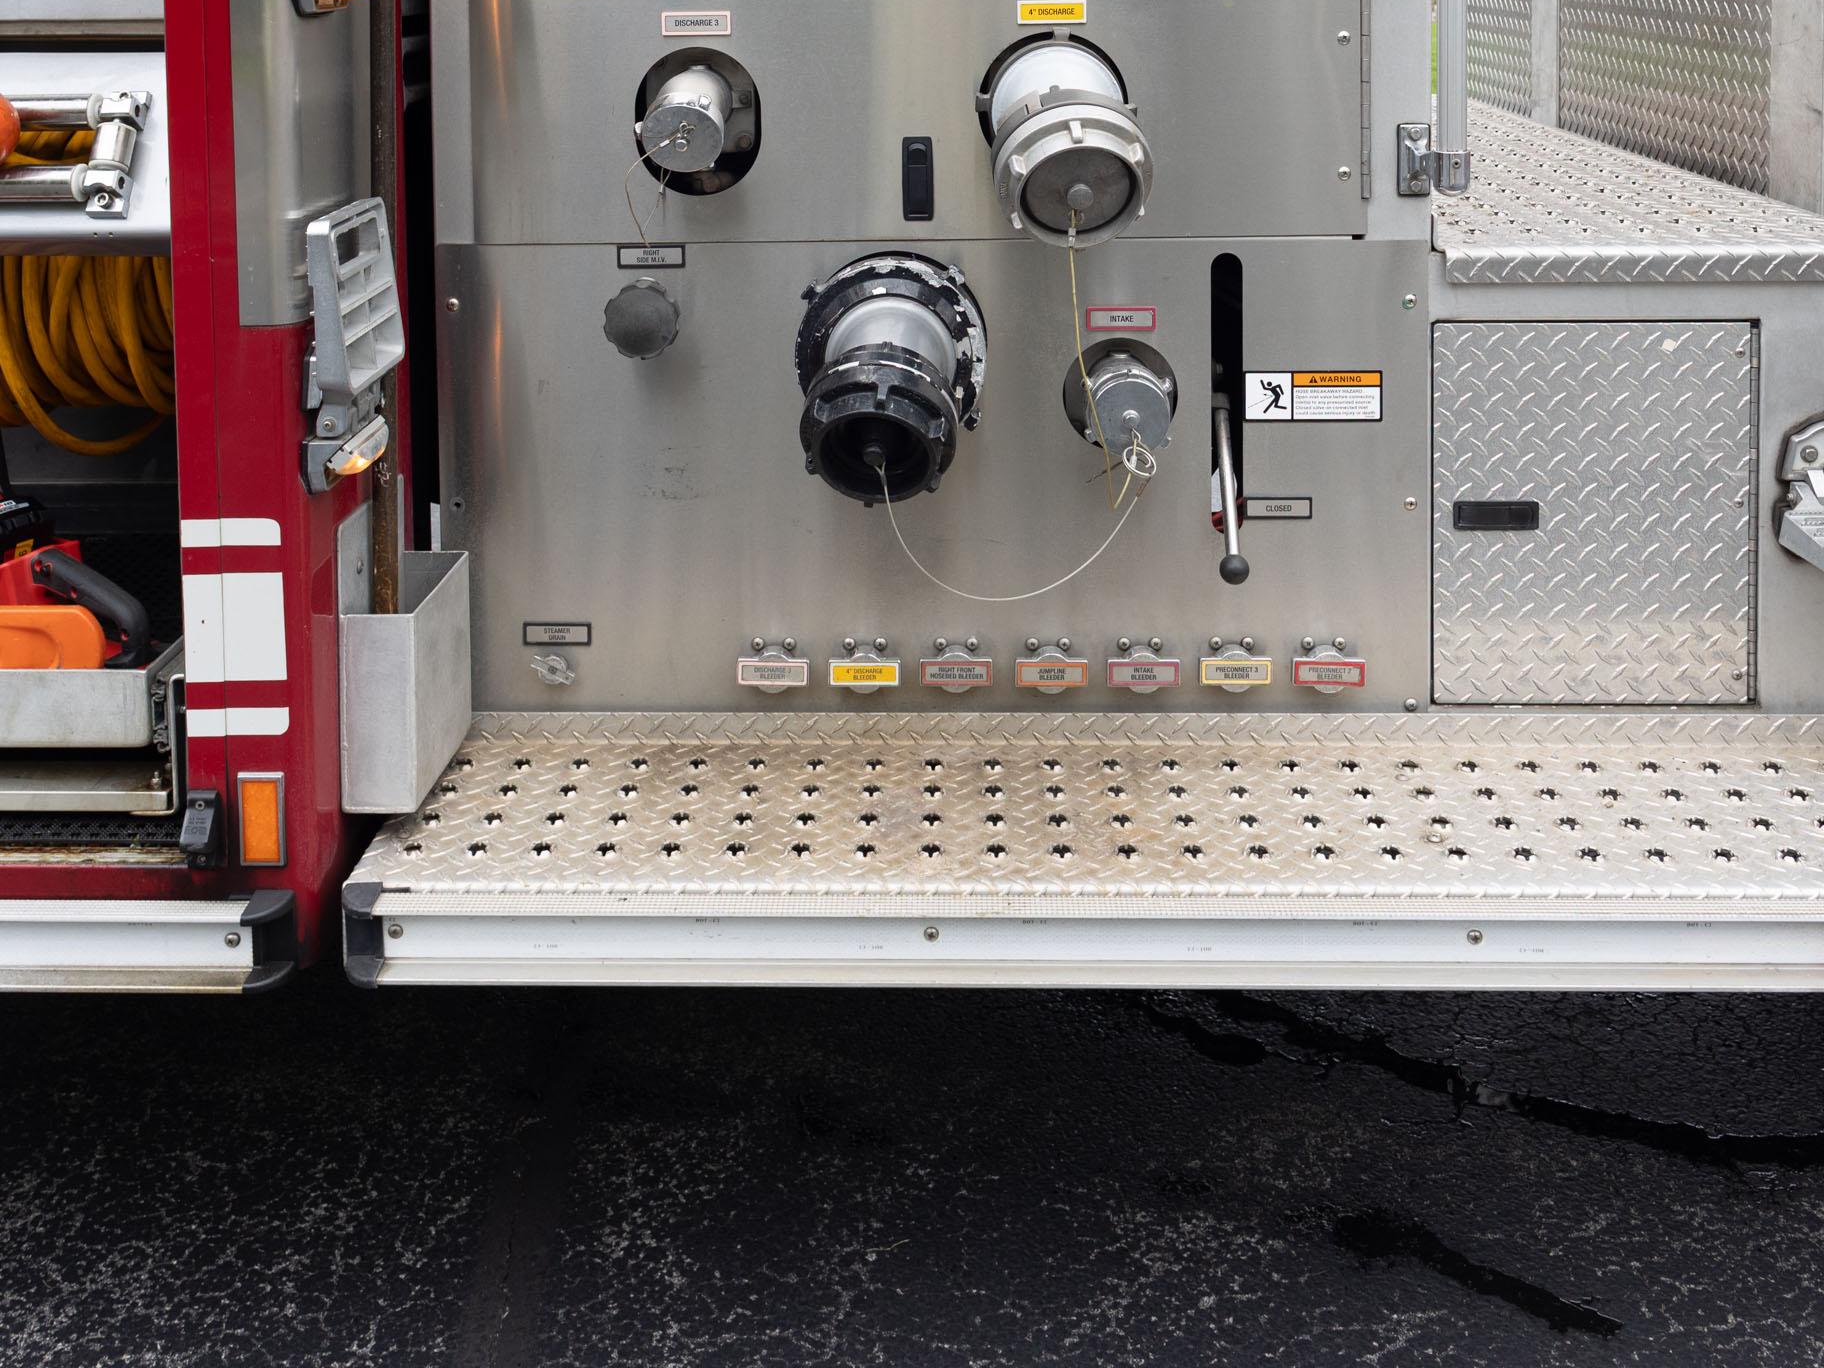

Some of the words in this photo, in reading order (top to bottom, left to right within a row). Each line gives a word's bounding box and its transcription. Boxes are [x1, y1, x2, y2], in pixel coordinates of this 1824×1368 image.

[1038, 7, 1075, 16] DISCHARGE
[674, 18, 713, 27] DISCHARGE
[714, 18, 719, 26] 3
[1320, 375, 1362, 383] WARNING
[1265, 504, 1292, 512] CLOSED
[1308, 666, 1346, 674] PRECONNECT
[1130, 673, 1157, 681] BLEEDER
